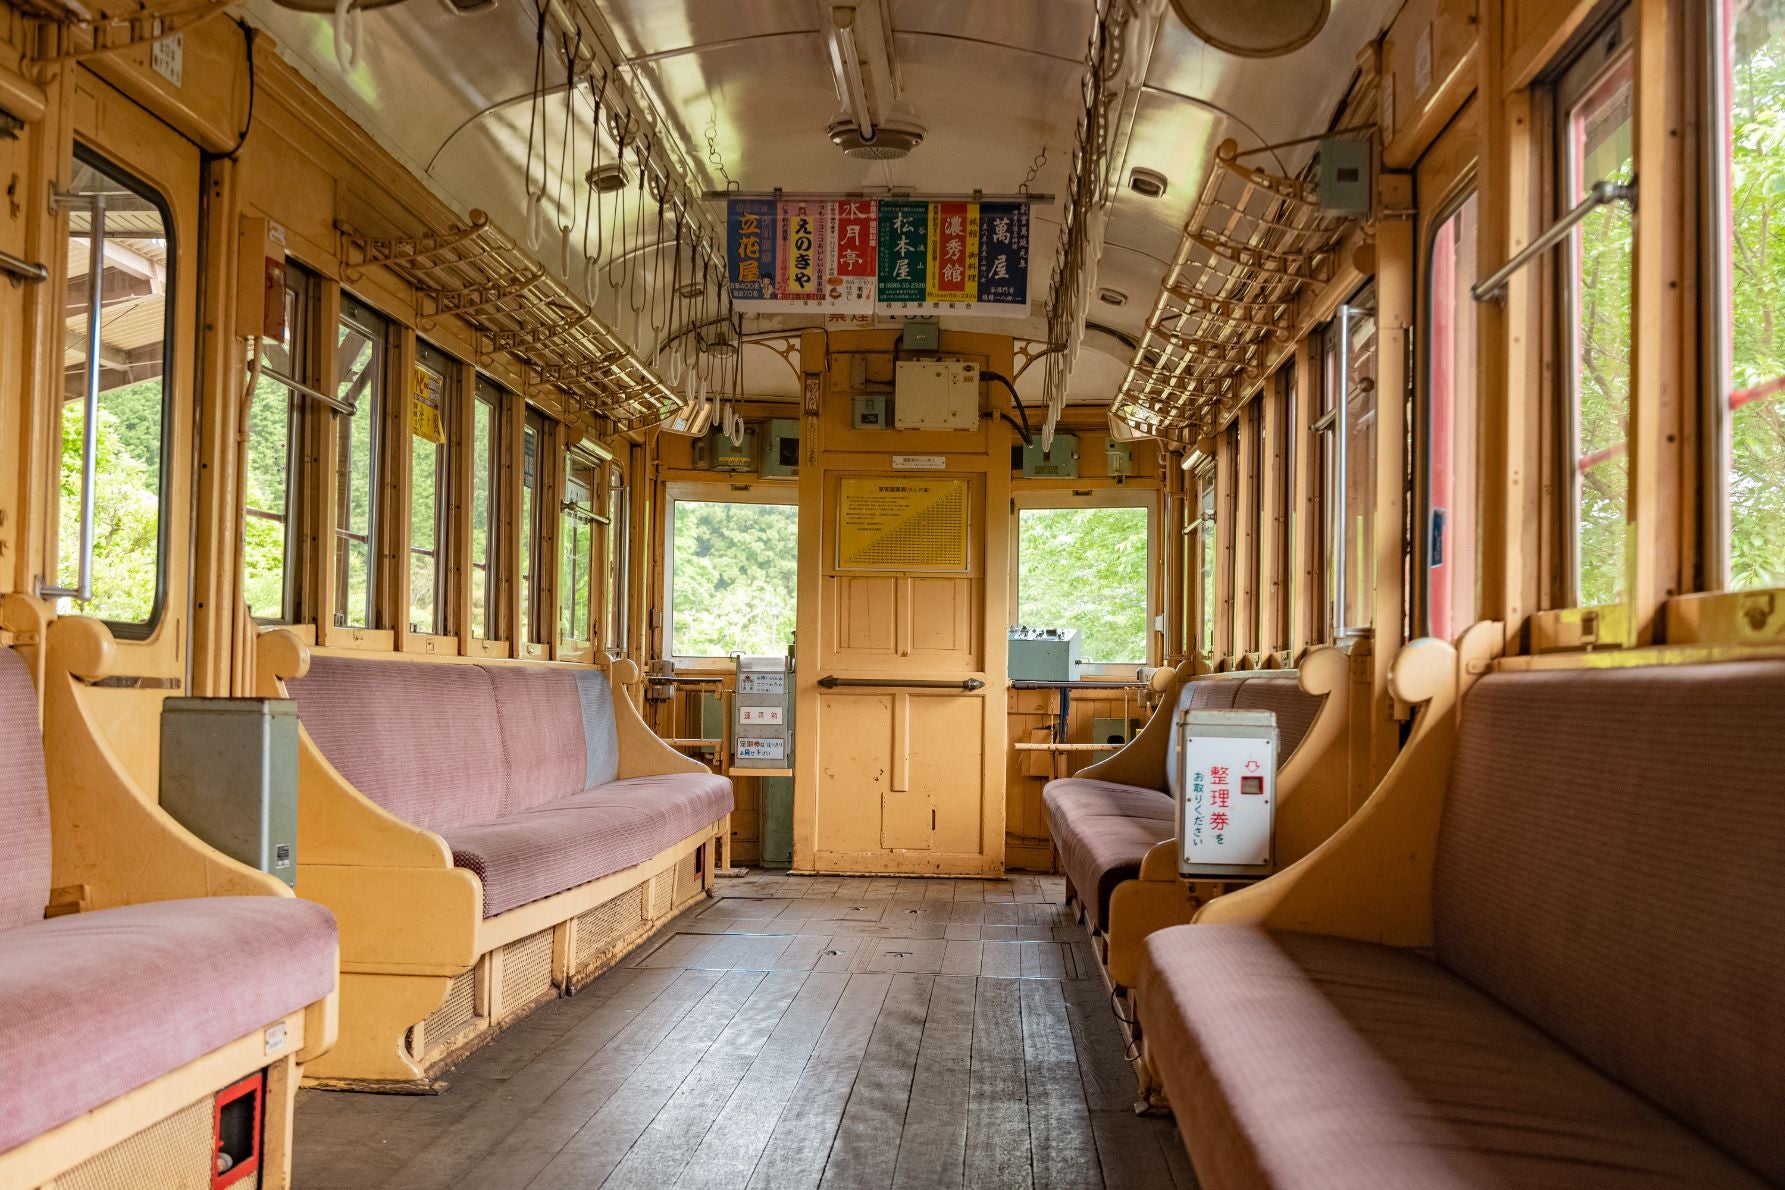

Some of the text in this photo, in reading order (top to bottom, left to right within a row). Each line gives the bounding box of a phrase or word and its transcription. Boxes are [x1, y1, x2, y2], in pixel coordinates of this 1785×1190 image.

[737, 211, 761, 282] 立花屋
[794, 217, 813, 290] えのきや
[840, 202, 868, 271] 水月亭
[893, 211, 915, 280] 松本屋
[942, 215, 965, 283] 濃秀館
[989, 217, 1010, 280] 萬屋
[1193, 772, 1205, 847] お取りください
[1209, 765, 1230, 845] 整理券を
